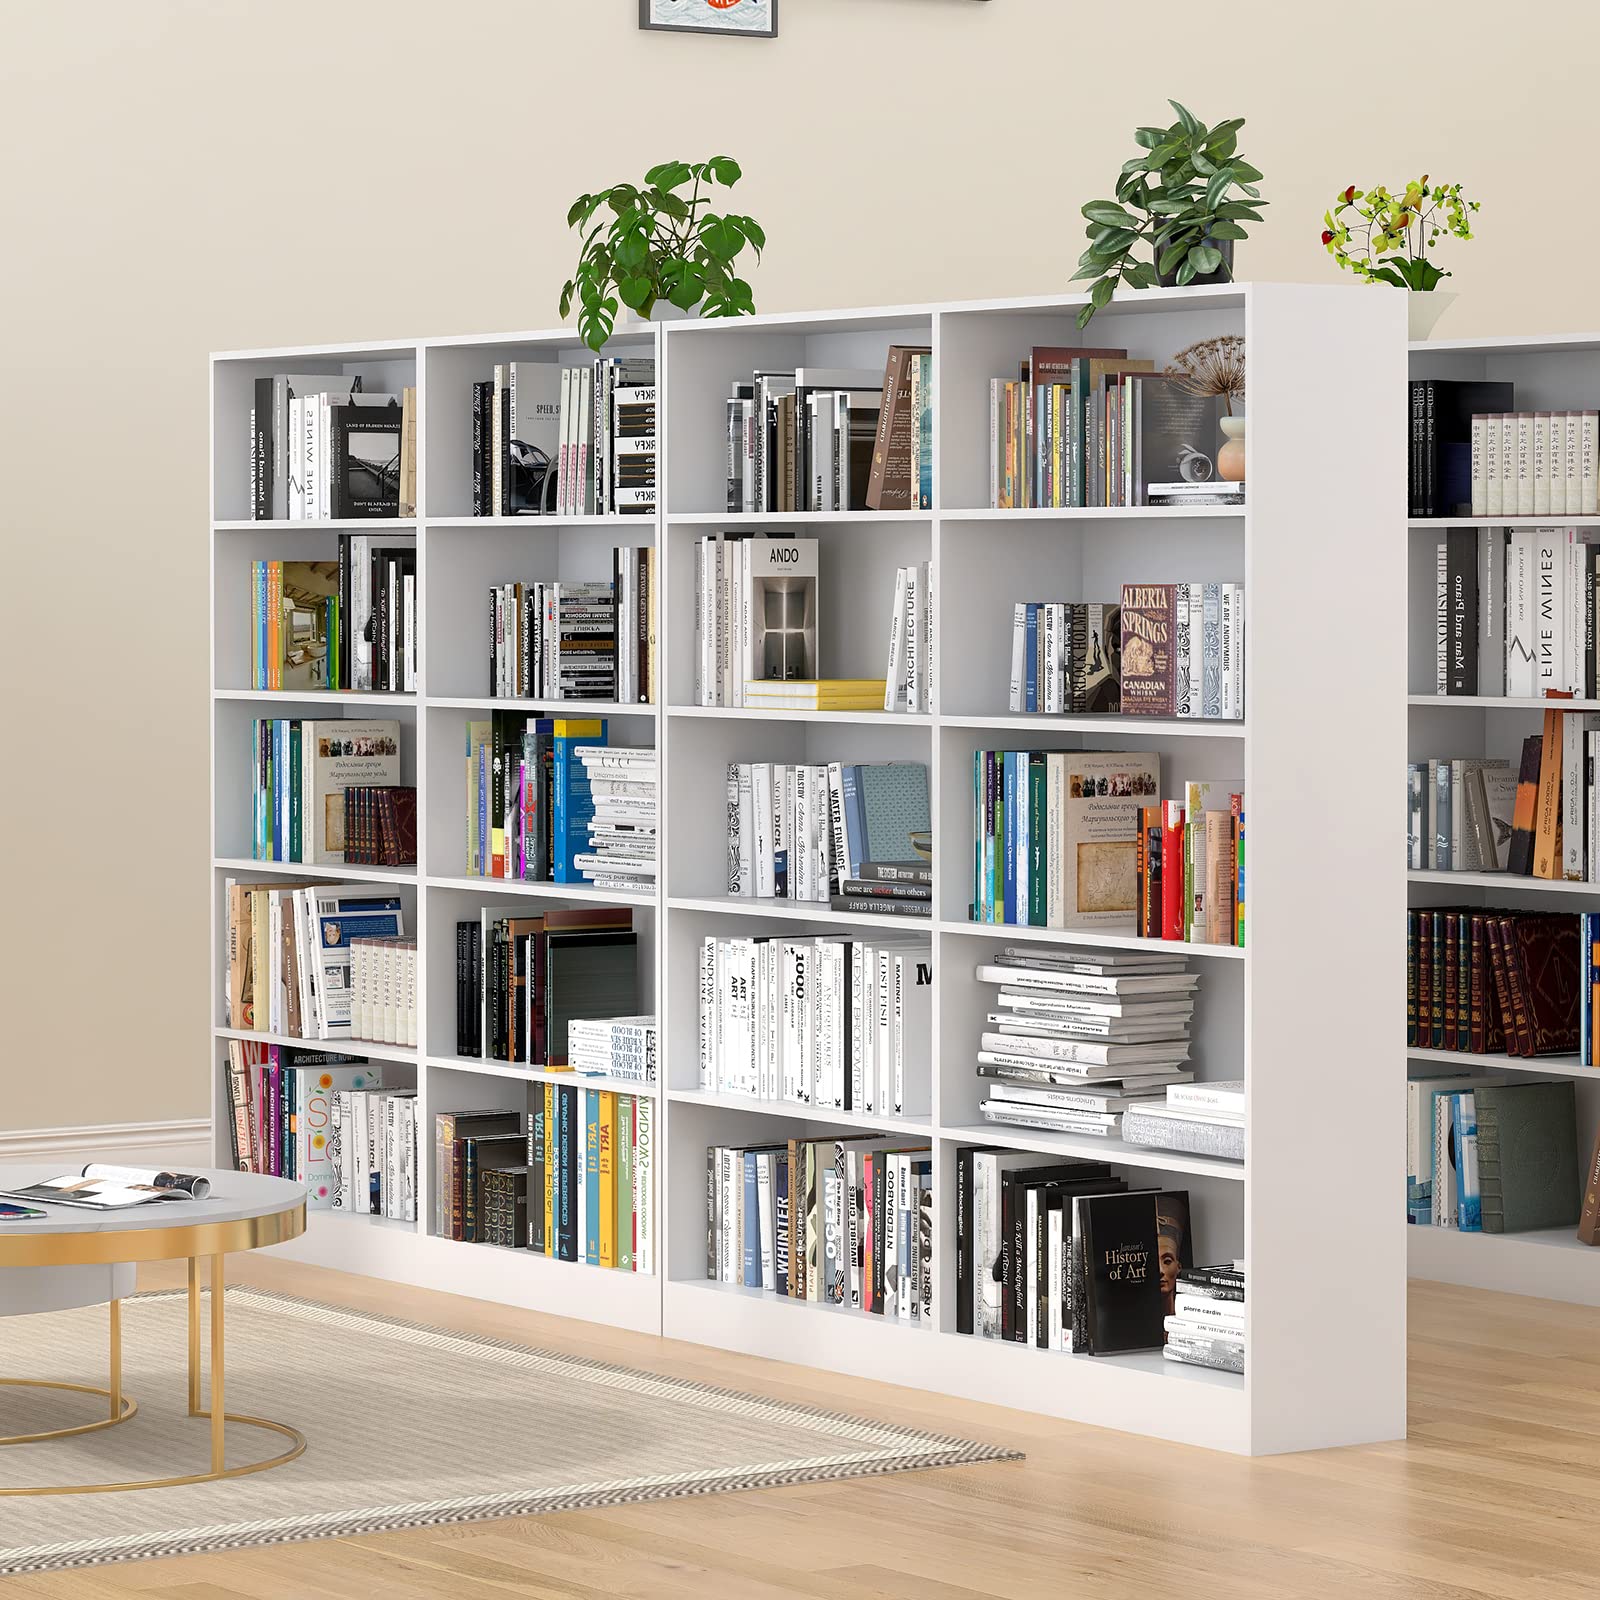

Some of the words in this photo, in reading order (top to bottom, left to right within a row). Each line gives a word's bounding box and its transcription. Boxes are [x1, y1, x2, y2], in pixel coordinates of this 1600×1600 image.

[880, 402, 890, 442] CHARLOTTE
[770, 548, 798, 563] ANDO
[716, 599, 722, 609] &
[1123, 587, 1167, 609] ALBERTA
[1223, 593, 1229, 606] WE
[640, 614, 647, 622] TO
[1072, 604, 1087, 651] HOLMES
[1123, 611, 1168, 644] SPRINGS
[1072, 652, 1087, 713] SHERLOCK
[1124, 681, 1165, 690] CANADIAN
[831, 789, 841, 823] WATER
[835, 825, 845, 871] FINANCE
[796, 836, 804, 886] Karenina
[872, 886, 892, 894] sicker
[893, 887, 907, 895] than
[908, 888, 926, 896] others
[849, 902, 868, 910] GRAFF
[903, 904, 919, 912] VESSEL
[796, 953, 804, 999] 1000
[853, 948, 862, 1002] ALEXEY
[896, 1006, 900, 1017] IT
[612, 1026, 633, 1037] BLOOD
[634, 1029, 642, 1038] OF
[612, 1043, 633, 1054] BLOOD
[634, 1046, 642, 1055] OF
[294, 1053, 338, 1064] ARCHITECTURE
[853, 1004, 862, 1109] BRODOVITCH
[612, 1060, 633, 1070] BLOOD
[634, 1063, 642, 1071] OF
[233, 1077, 241, 1101] ORWELL
[1047, 1093, 1065, 1102] exists
[1066, 1096, 1095, 1106] Unicorns
[308, 1098, 327, 1127] S
[958, 1160, 964, 1170] To
[825, 1177, 835, 1259] OCEAN
[1015, 1220, 1023, 1231] To
[777, 1196, 788, 1274] WHINTER
[1015, 1232, 1023, 1250] Kill
[1104, 1249, 1149, 1266] History
[1109, 1269, 1122, 1281] of
[1125, 1266, 1147, 1279] Art
[1015, 1257, 1023, 1310] Mockingbird
[1067, 1277, 1072, 1286] OF
[1202, 1308, 1221, 1316] cardin
